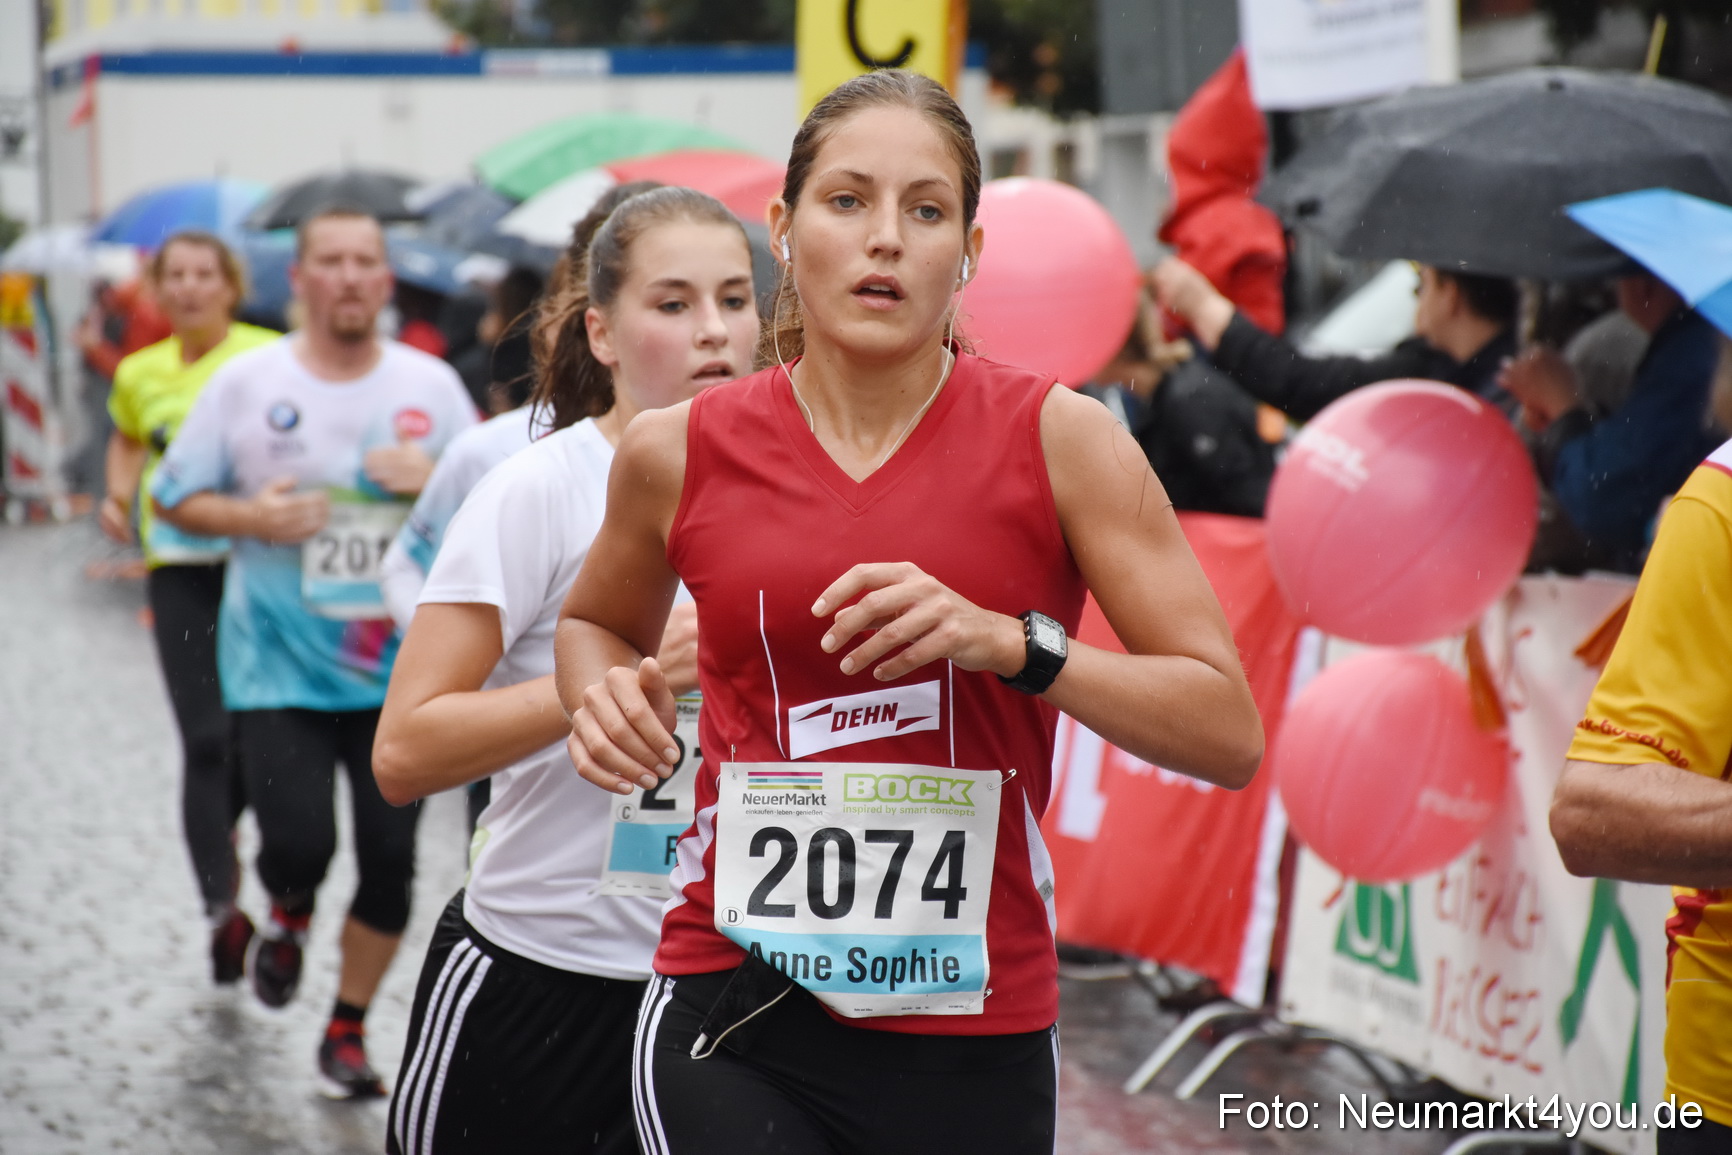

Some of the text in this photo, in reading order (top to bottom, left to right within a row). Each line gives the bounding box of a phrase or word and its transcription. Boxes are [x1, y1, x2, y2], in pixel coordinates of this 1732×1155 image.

[831, 702, 898, 733] DEHN
[742, 793, 827, 806] NeuerMarkt
[844, 773, 976, 807] BOCK
[843, 804, 976, 817] inspired by smart concepts
[747, 826, 967, 920] 2074
[727, 909, 738, 923] D
[847, 946, 961, 991] Sophie
